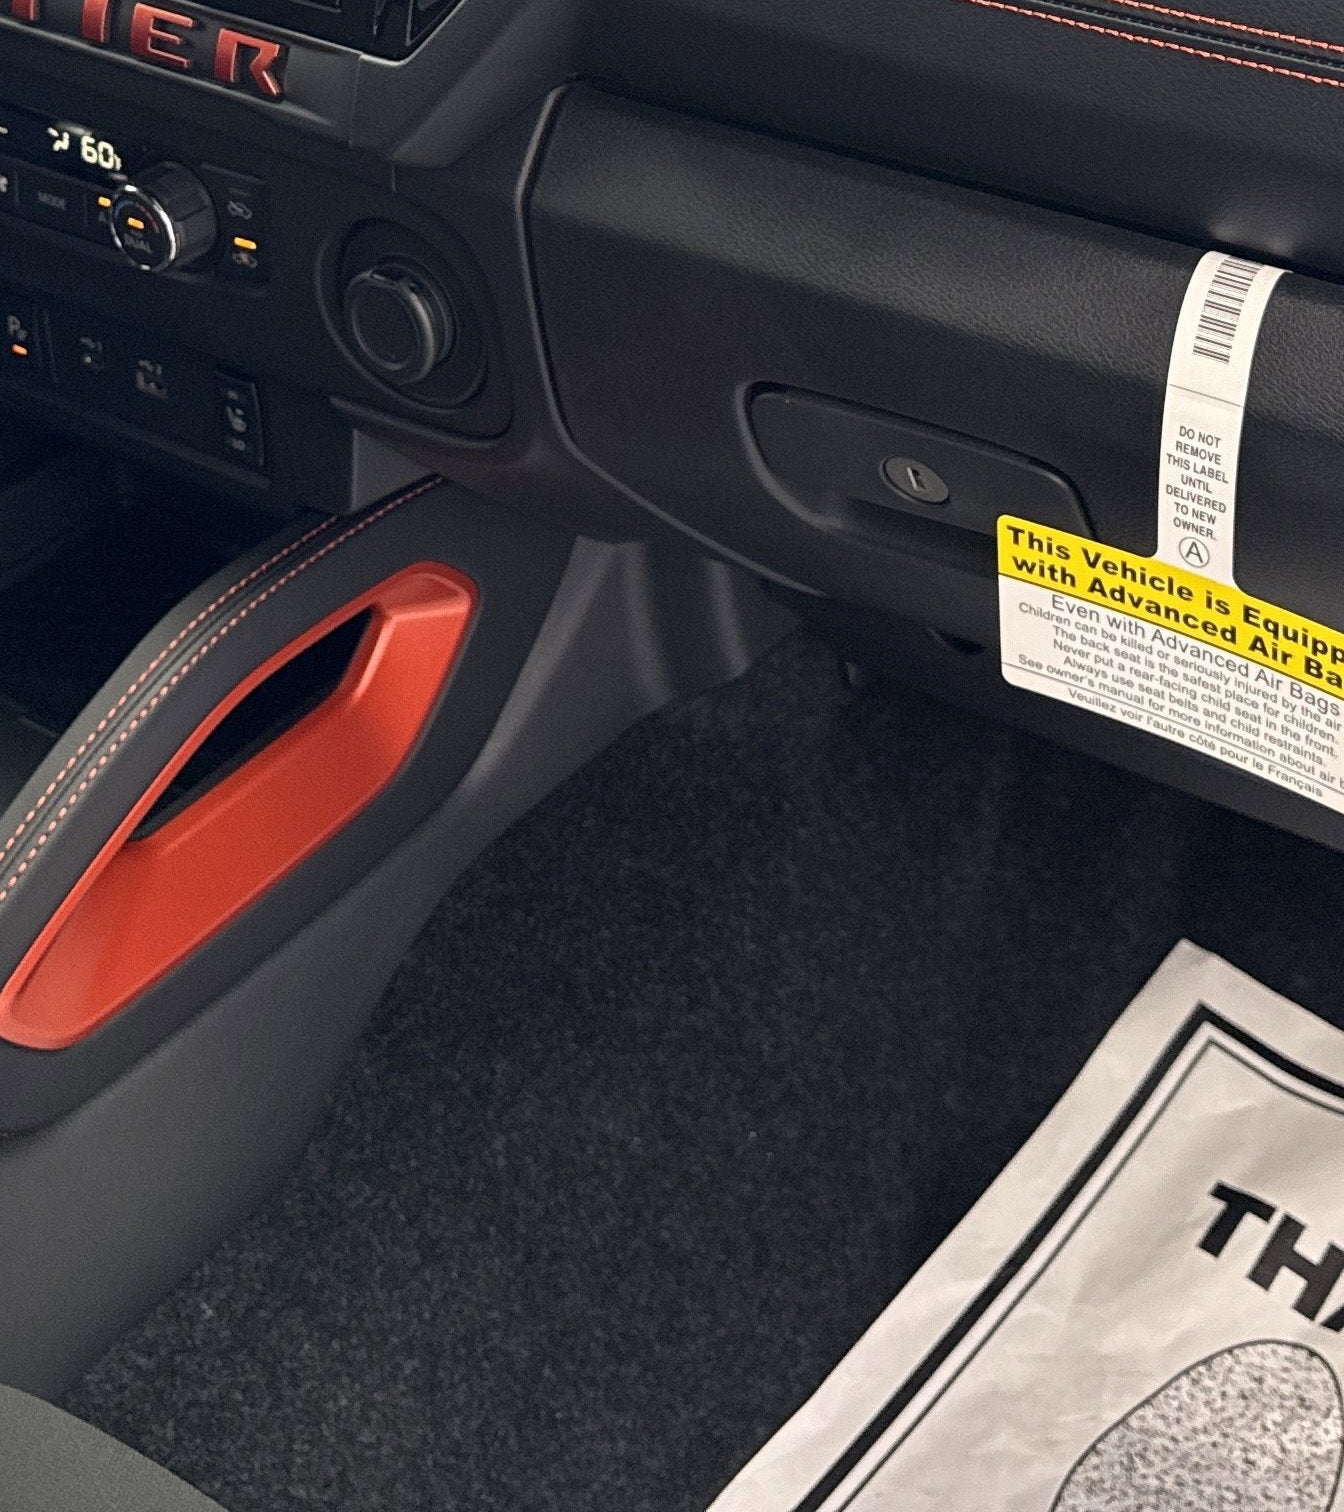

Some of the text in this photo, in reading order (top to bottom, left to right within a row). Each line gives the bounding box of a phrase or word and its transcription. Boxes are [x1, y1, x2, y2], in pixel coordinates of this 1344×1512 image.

[1166, 452, 1229, 484] THIS LABEL
[1176, 440, 1221, 466] REMOVE
[1179, 425, 1221, 449] DO NOT
[1181, 474, 1212, 494] UNTIL
[1166, 484, 1227, 514] DELIVERED
[1174, 501, 1217, 525] TO NEW
[1006, 524, 1071, 561] This
[1081, 546, 1193, 602] Vehicle
[1205, 589, 1231, 616] is
[1185, 541, 1204, 564] A
[1012, 555, 1077, 588] with
[1087, 576, 1237, 645] Advanced
[1248, 634, 1294, 666] Air
[1052, 594, 1341, 717] Even with Advanced Air Bags
[1019, 601, 1071, 626] Children
[1074, 620, 1097, 637] can
[1101, 627, 1118, 642] be
[1121, 633, 1153, 655] killed
[1157, 648, 1172, 661] or
[1173, 655, 1231, 685] seriously
[1234, 678, 1279, 704] injured
[1281, 696, 1297, 713] by
[1301, 705, 1321, 723] the
[1325, 716, 1343, 732] air
[1053, 625, 1339, 745] The back seat is the safest place for children.
[1053, 638, 1338, 760] Never put a rear-facing child seat in the front.
[1063, 655, 1327, 767] Always use seat belts and child restraints.
[1018, 654, 1043, 671] See
[1046, 663, 1095, 688] owner's
[1099, 681, 1145, 705] manual
[1149, 697, 1165, 713] for
[1168, 708, 1201, 727] more
[1204, 721, 1276, 758] information
[1279, 752, 1316, 776] about
[1319, 769, 1336, 785] air
[1068, 688, 1323, 797] Veuillez voir l'autre côté pour le Français
